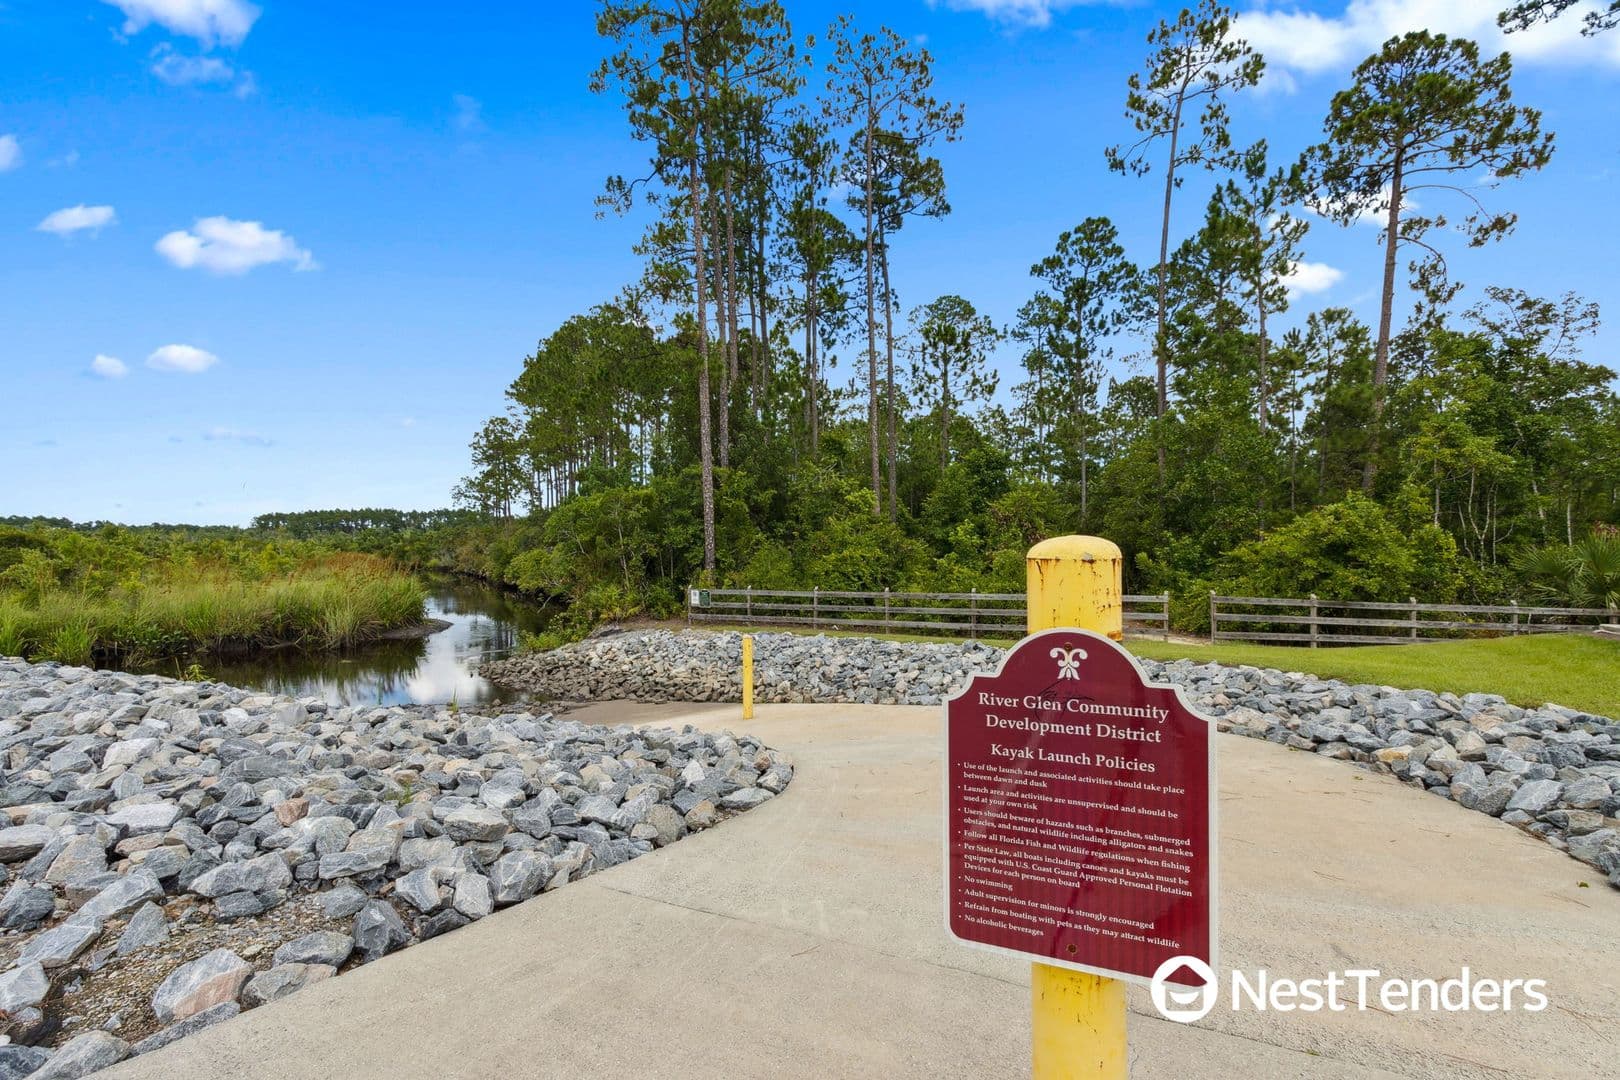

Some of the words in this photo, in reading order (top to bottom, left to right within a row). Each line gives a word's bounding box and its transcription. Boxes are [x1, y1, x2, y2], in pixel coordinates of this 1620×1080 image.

[979, 692, 1019, 707] River
[1023, 695, 1061, 711] Glen
[1067, 699, 1169, 723] Community
[986, 714, 1091, 737] Development
[1097, 724, 1161, 743] District
[991, 744, 1034, 760] Kayak
[1039, 749, 1091, 765] Launch
[1096, 755, 1155, 773] Policies
[964, 772, 992, 781] between
[994, 775, 1012, 783] dawn
[1030, 780, 1047, 788] dusk
[999, 766, 1022, 775] launch
[1039, 772, 1076, 781] associated
[1078, 777, 1112, 786] activities
[1114, 780, 1141, 789] should
[1163, 786, 1184, 794] place
[964, 785, 989, 793] Launch
[1021, 793, 1055, 802] activities
[1068, 798, 1118, 811] unsupervised
[1138, 808, 1166, 817] should
[1168, 811, 1178, 819] be
[989, 798, 1005, 807] your
[964, 807, 982, 815] Users
[984, 809, 1008, 819] should
[1009, 814, 1035, 823] beware
[1046, 819, 1074, 828] hazards
[1105, 827, 1143, 839] branches,
[1145, 834, 1191, 846] submerged
[964, 818, 996, 828] obstacles,
[998, 822, 1011, 830] and
[1013, 825, 1038, 833] natural
[1039, 829, 1069, 838] wildlife
[1071, 833, 1107, 845] including
[1109, 838, 1146, 849] alligators
[1165, 848, 1193, 857] snakes
[964, 830, 987, 839] Follow
[1000, 835, 1024, 844] Florida
[1058, 844, 1090, 855] Wildlife
[1091, 852, 1135, 862] regulations
[1137, 858, 1159, 866] when
[1161, 860, 1190, 873] fishing
[976, 845, 993, 853] State
[995, 847, 1011, 857] Law,
[1024, 852, 1042, 861] boats
[1045, 856, 1080, 869] including
[1082, 863, 1107, 872] canoes
[1126, 869, 1154, 880] kayaks
[1156, 875, 1176, 883] must
[964, 862, 990, 872] Devices
[992, 866, 1002, 874] for
[1004, 869, 1020, 877] each
[1021, 873, 1045, 882] person
[1059, 878, 1080, 888] board
[964, 854, 996, 864] equipped
[998, 858, 1014, 866] with
[1016, 861, 1030, 869] U.S.
[1032, 864, 1052, 873] Coast
[1054, 868, 1078, 878] Guard
[1080, 872, 1117, 884] Approved
[1120, 879, 1153, 890] Personal
[1155, 885, 1192, 897] Flotation
[976, 878, 1013, 891] swimming
[964, 889, 984, 897] Adult
[985, 893, 1026, 905] supervision
[1028, 898, 1038, 907] for
[1040, 903, 1066, 912] minors
[1067, 907, 1074, 915] is
[1075, 908, 1107, 921] strongly
[1108, 916, 1154, 929] encouraged
[964, 901, 989, 912] Refrain
[991, 906, 1008, 915] from
[1010, 909, 1037, 922] boating
[1039, 915, 1055, 924] with
[1057, 919, 1072, 928] pets
[1084, 924, 1100, 934] they
[1102, 929, 1119, 937] may
[1121, 933, 1145, 942] attract
[1147, 937, 1180, 948] wildlife
[976, 917, 1007, 929] alcoholic
[1009, 923, 1044, 936] beverages
